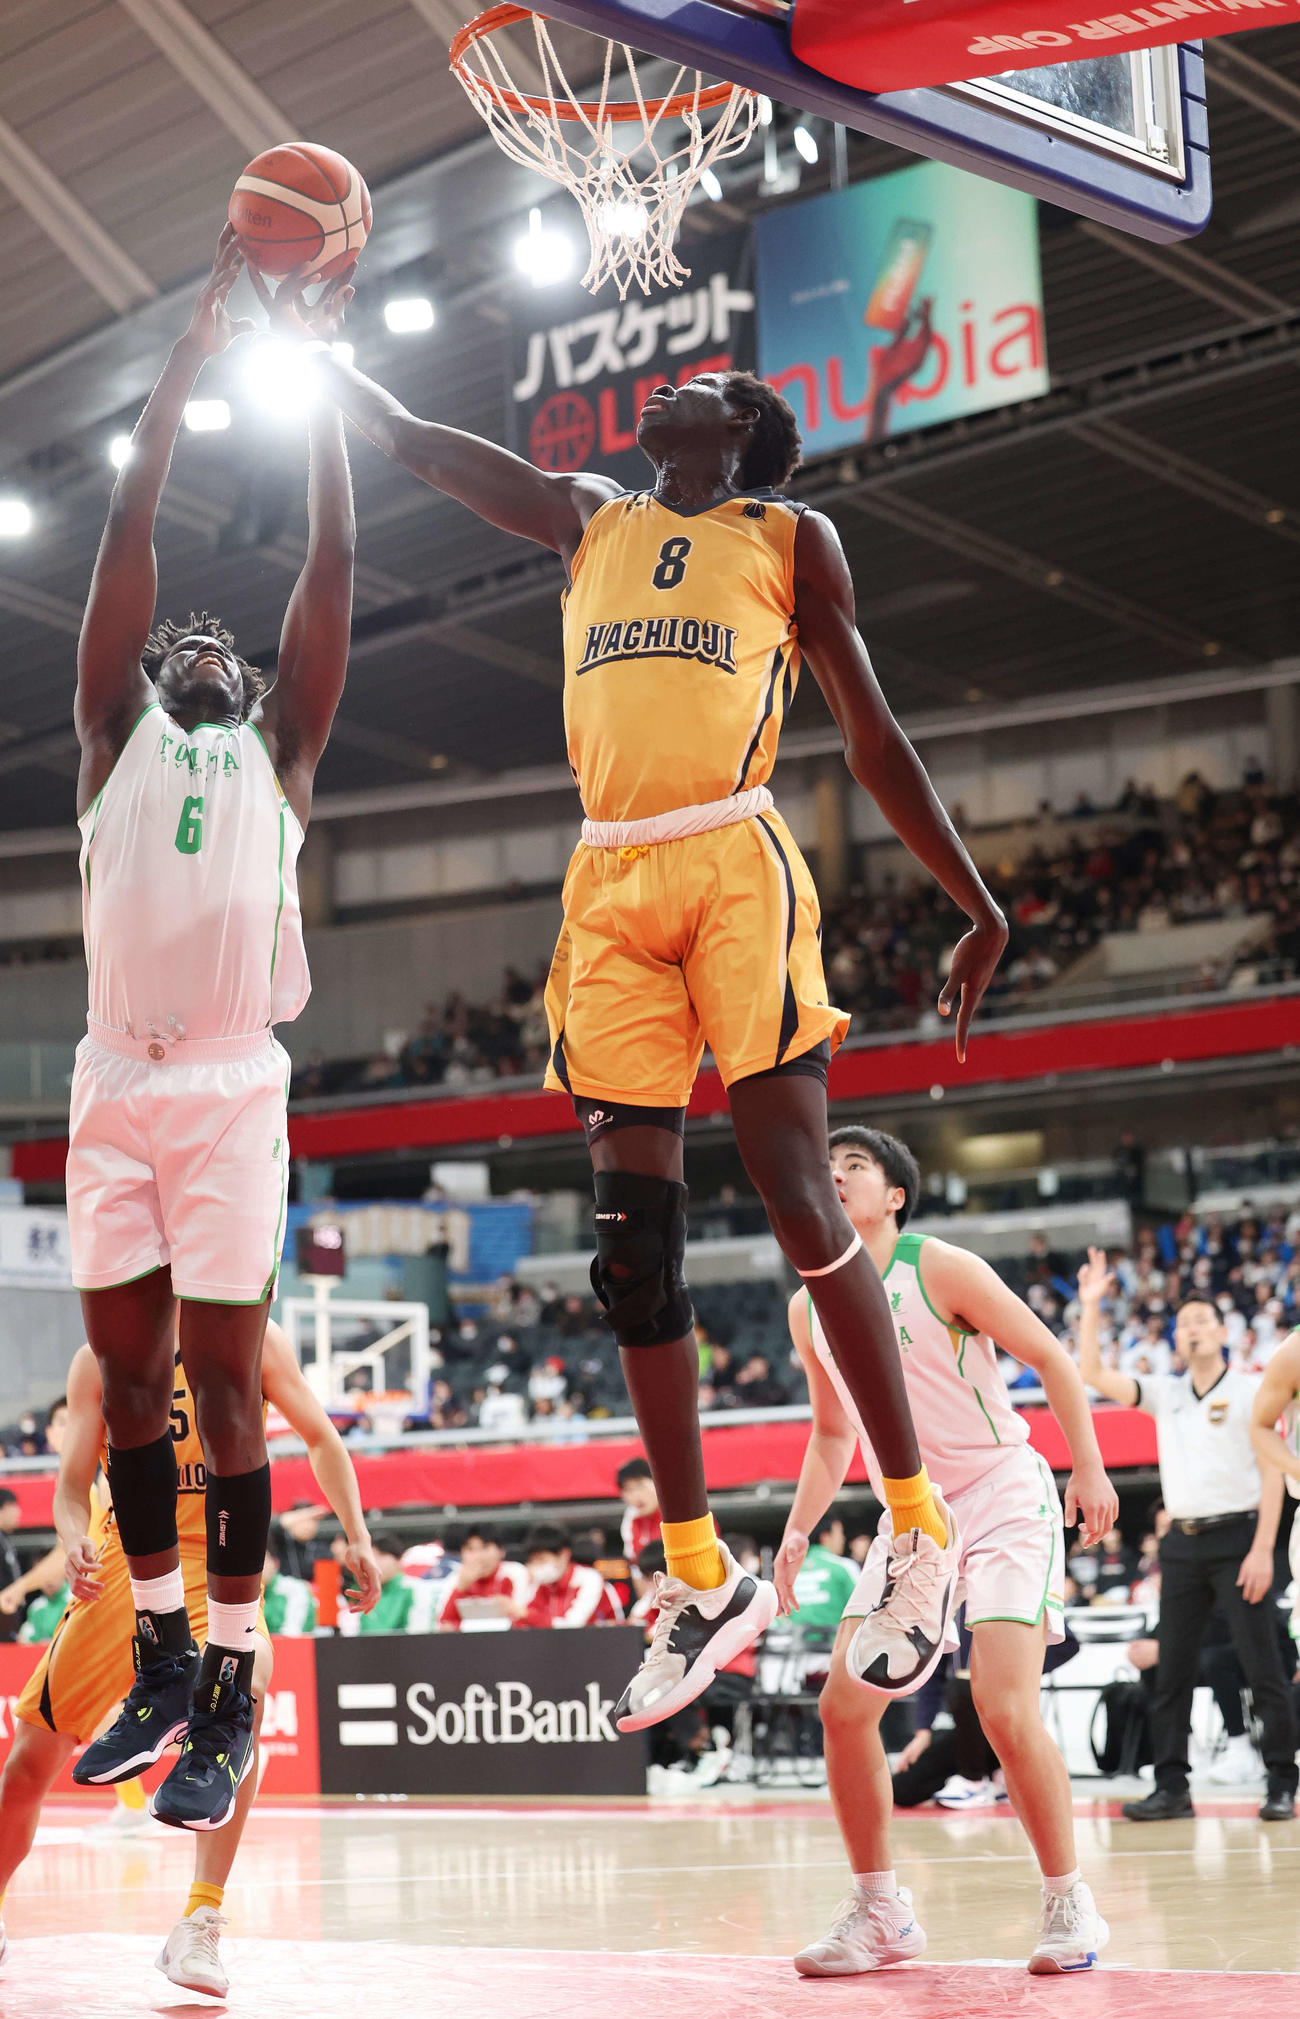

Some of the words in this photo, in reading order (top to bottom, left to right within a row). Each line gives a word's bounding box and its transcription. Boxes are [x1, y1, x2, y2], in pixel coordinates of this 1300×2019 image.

[967, 30, 1073, 55] CUP
[513, 272, 756, 402] バスケット
[651, 536, 693, 592] 8
[577, 616, 739, 675] HACHIOJI
[175, 795, 204, 855] 6
[406, 1681, 619, 1744] SoftBank
